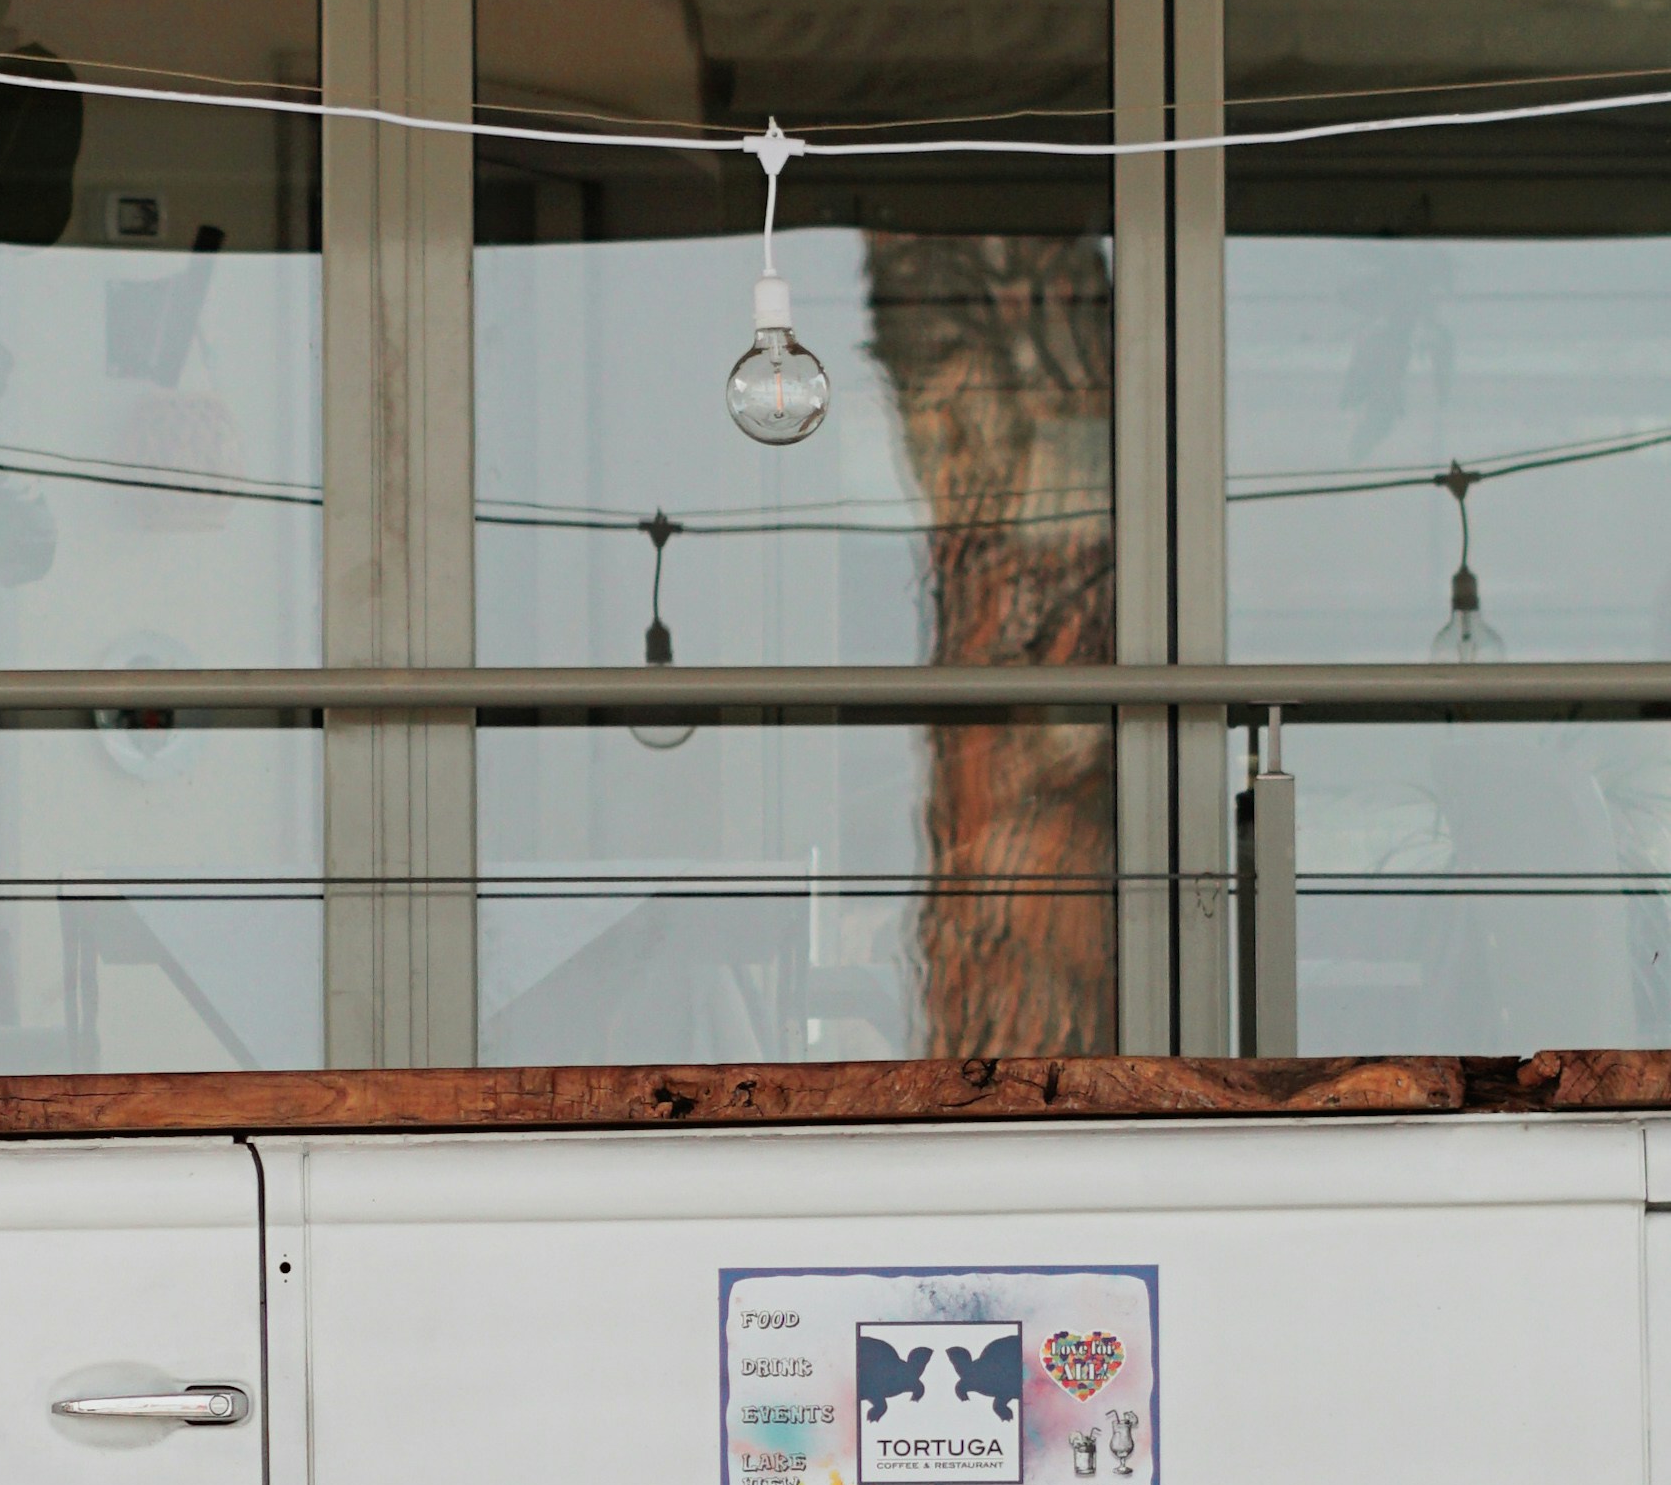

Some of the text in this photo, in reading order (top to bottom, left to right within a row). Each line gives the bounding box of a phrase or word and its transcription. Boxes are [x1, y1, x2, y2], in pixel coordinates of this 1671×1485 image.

[741, 1311, 799, 1329] FOOD
[1051, 1340, 1116, 1355] Love for
[742, 1358, 812, 1377] DRINK
[1061, 1363, 1108, 1381] ALL!
[742, 1405, 834, 1424] EVENTS
[877, 1440, 1003, 1456] TORTUGA
[742, 1453, 806, 1472] LAKE
